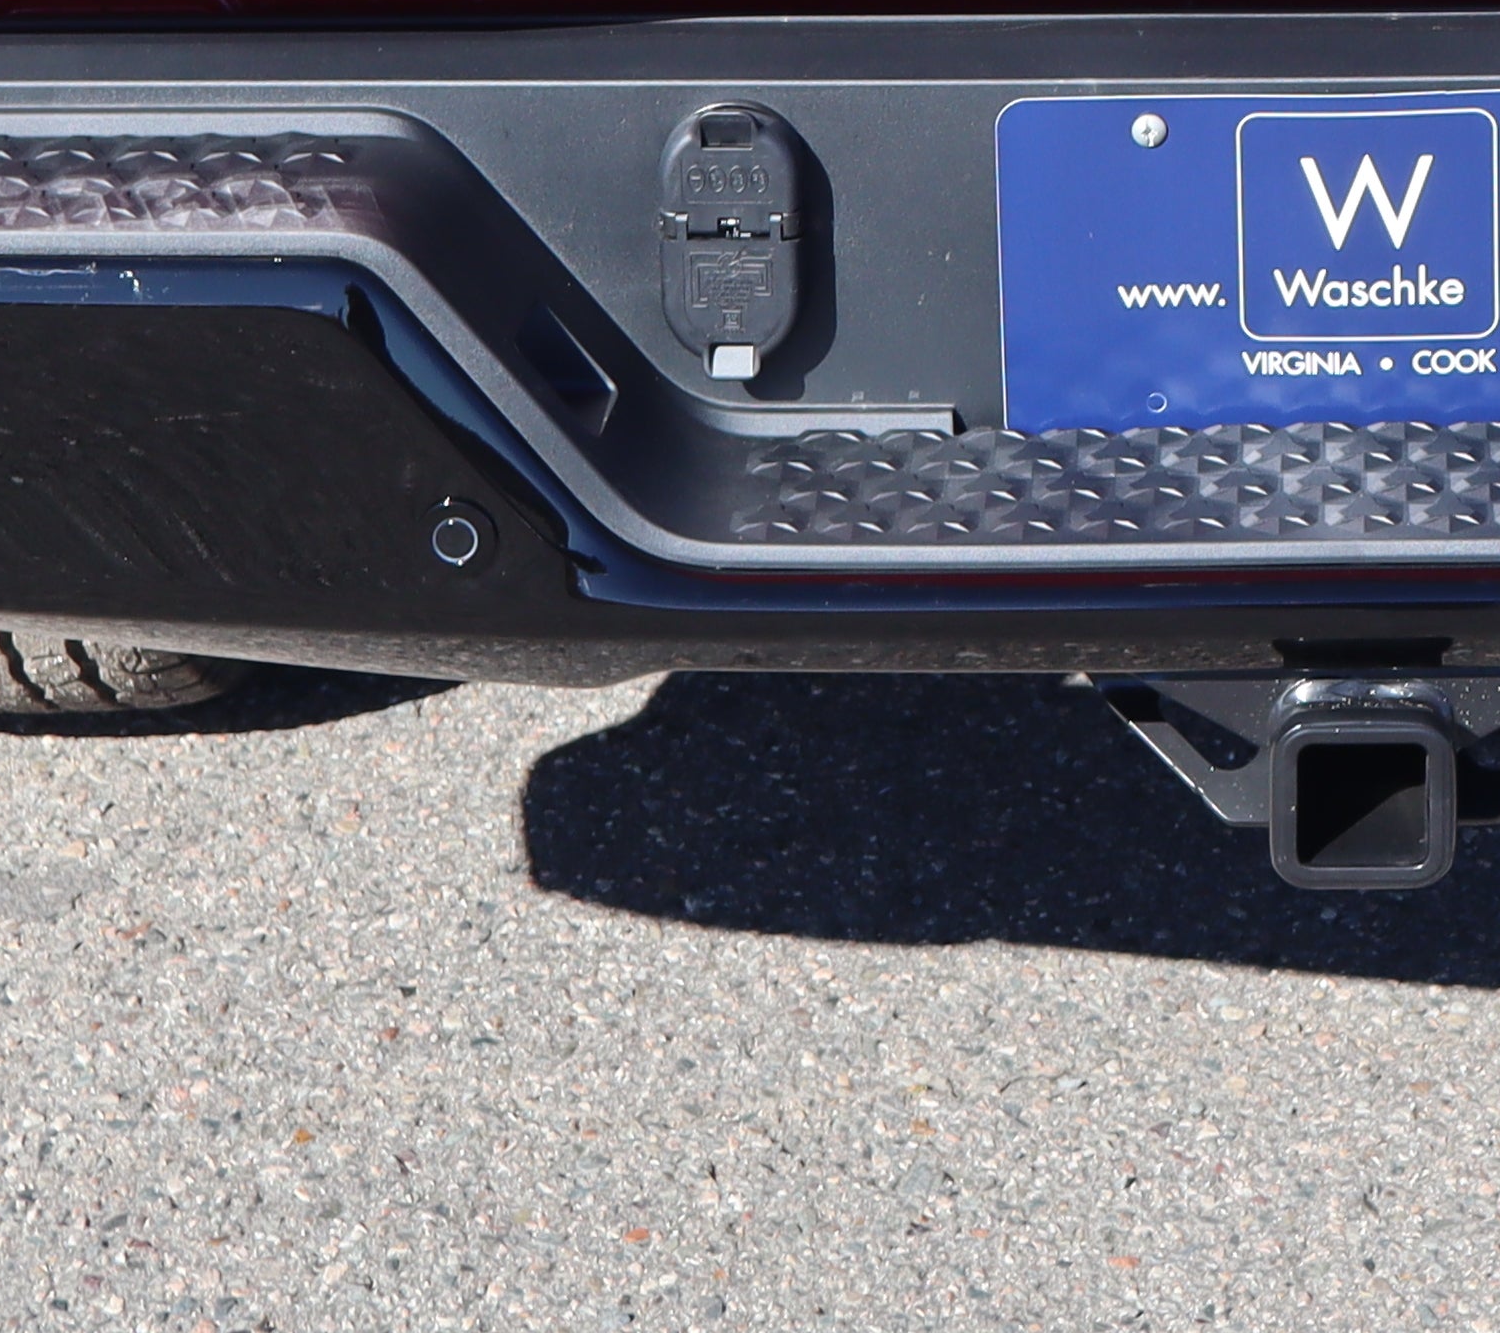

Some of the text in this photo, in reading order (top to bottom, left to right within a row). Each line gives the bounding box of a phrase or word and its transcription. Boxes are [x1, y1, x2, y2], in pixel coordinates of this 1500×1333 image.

[1300, 154, 1433, 250] W
[1117, 282, 1227, 308] www.
[1273, 264, 1465, 308] Waschke
[1242, 348, 1497, 376] VIRGINIA COOK
